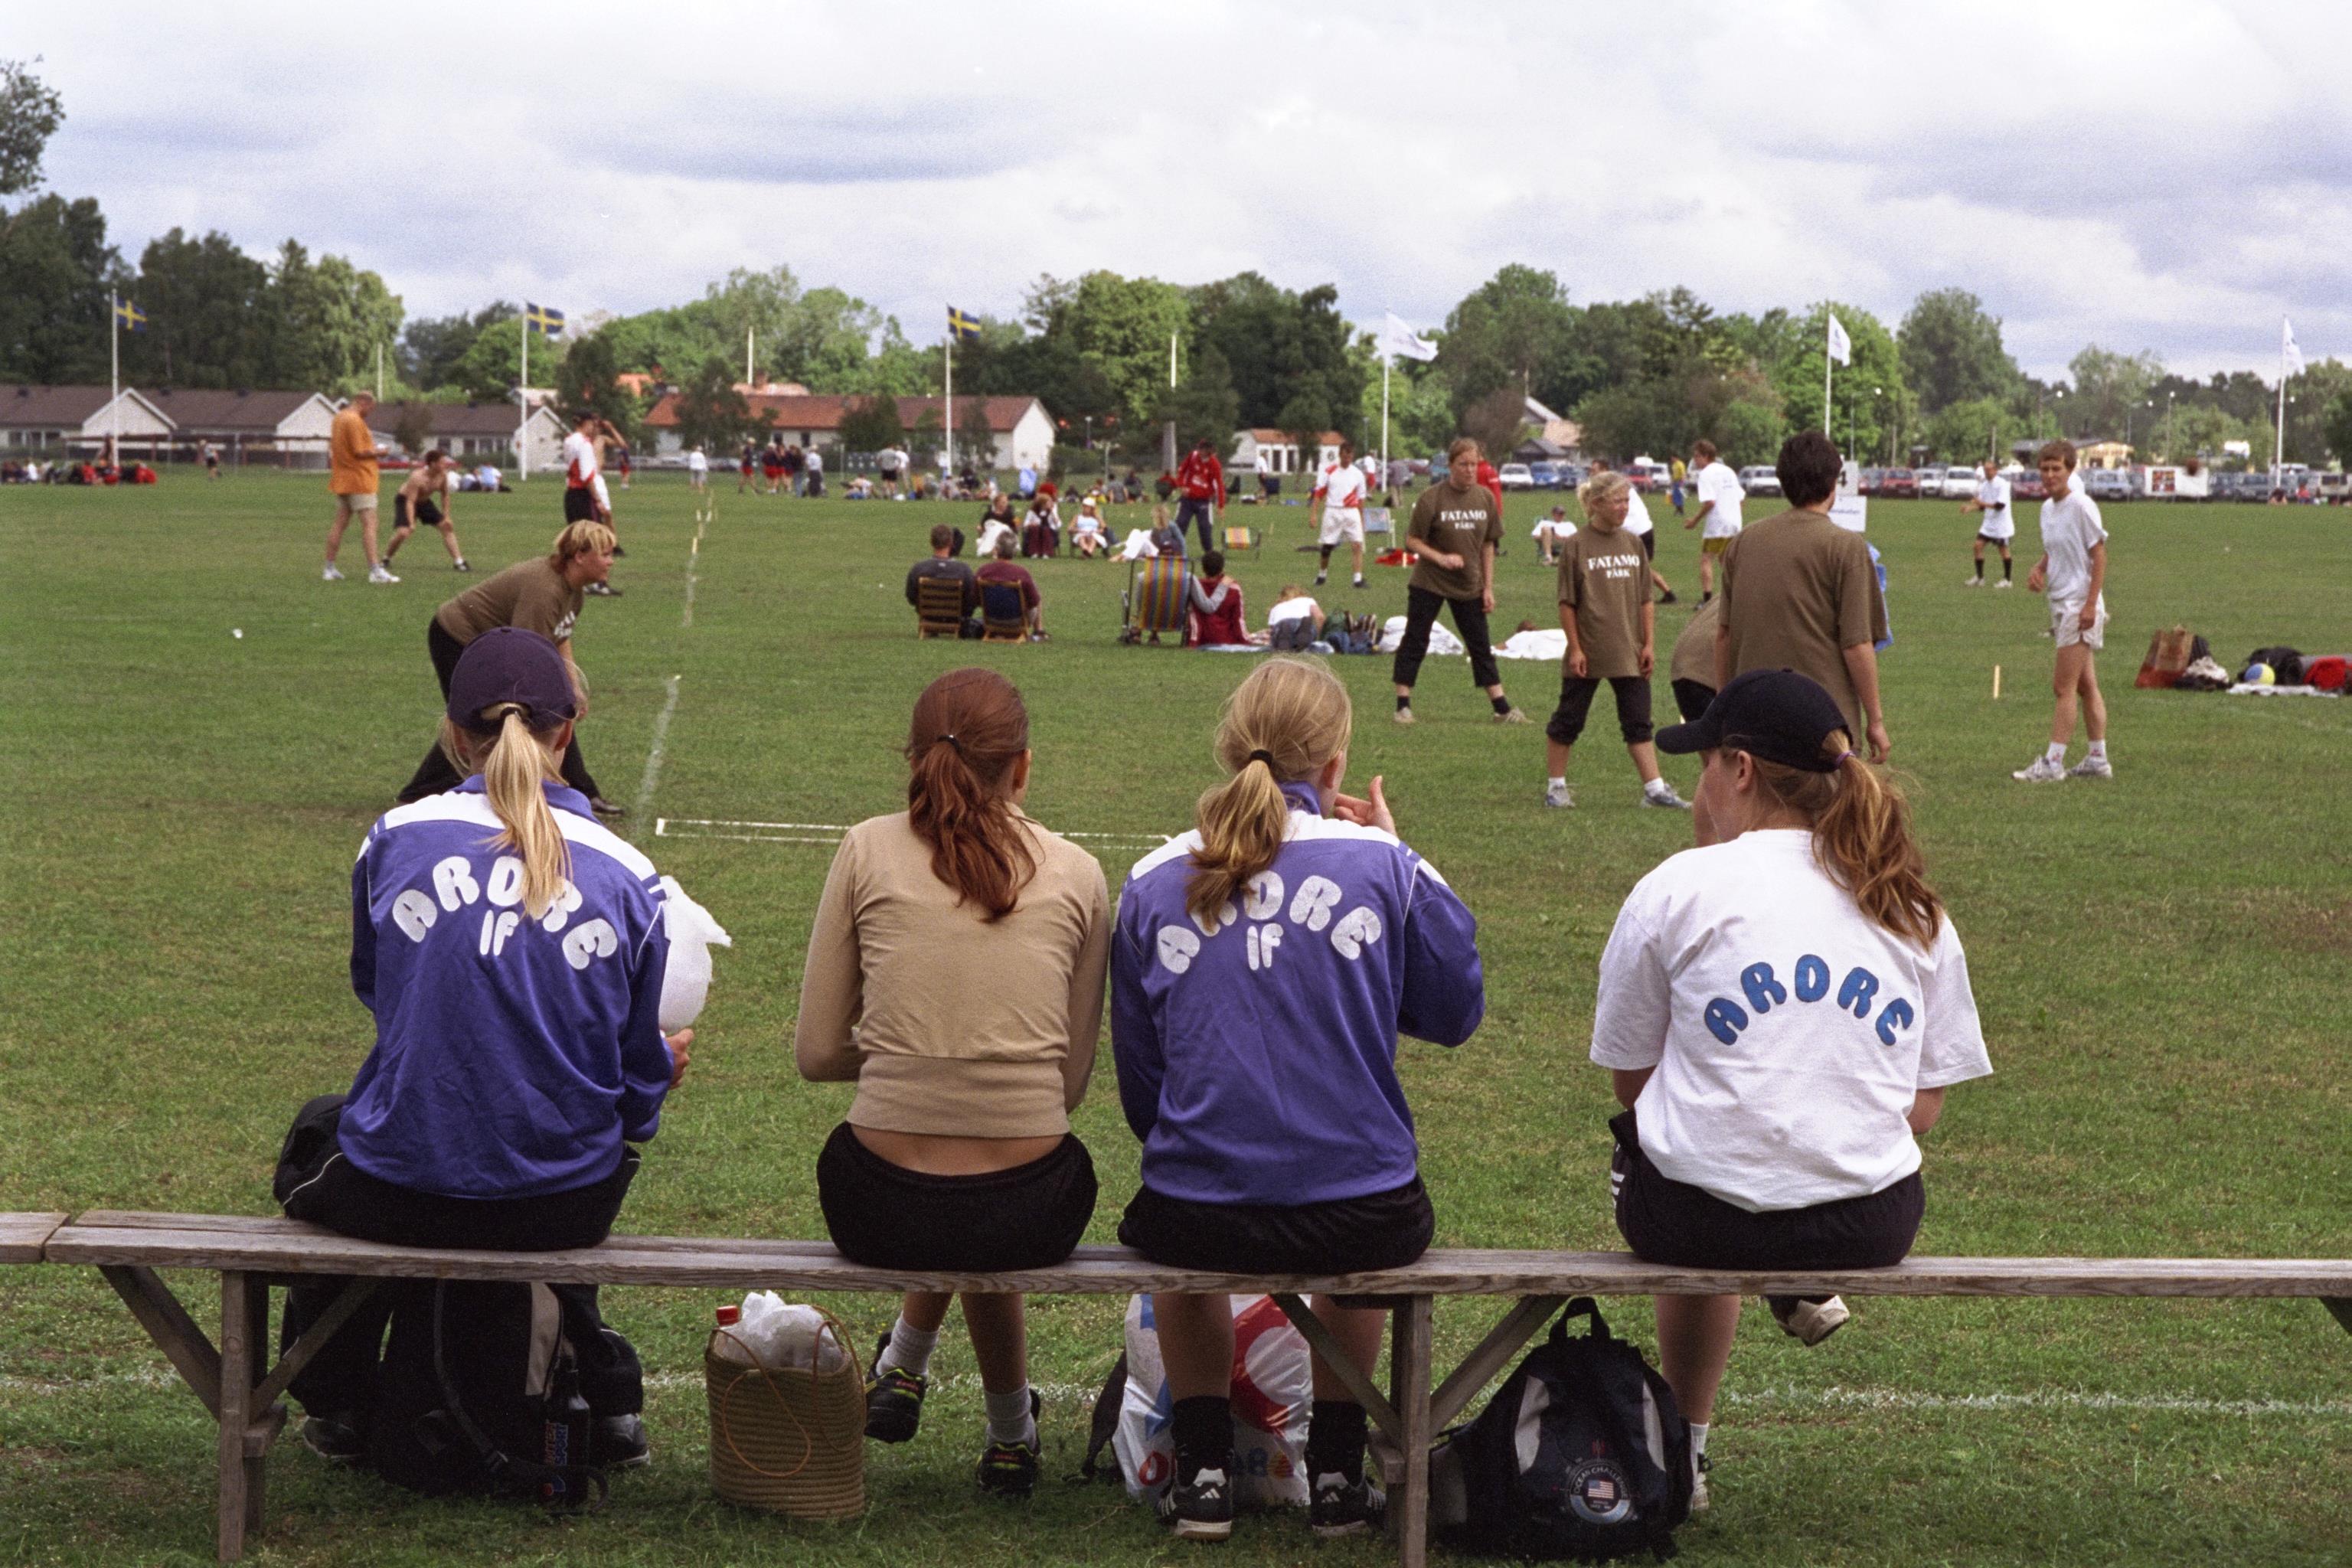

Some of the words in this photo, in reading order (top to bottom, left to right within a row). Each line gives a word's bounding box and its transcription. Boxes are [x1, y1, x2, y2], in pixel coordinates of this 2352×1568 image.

[1440, 509, 1487, 522] FATAMO
[1587, 554, 1641, 570] FATAMO
[479, 909, 520, 956] IF
[1246, 923, 1284, 972] IF
[1704, 953, 1914, 1046] ARDRE
[555, 1423, 569, 1466] SPORT
[1573, 1468, 1591, 1494] OCEAN
